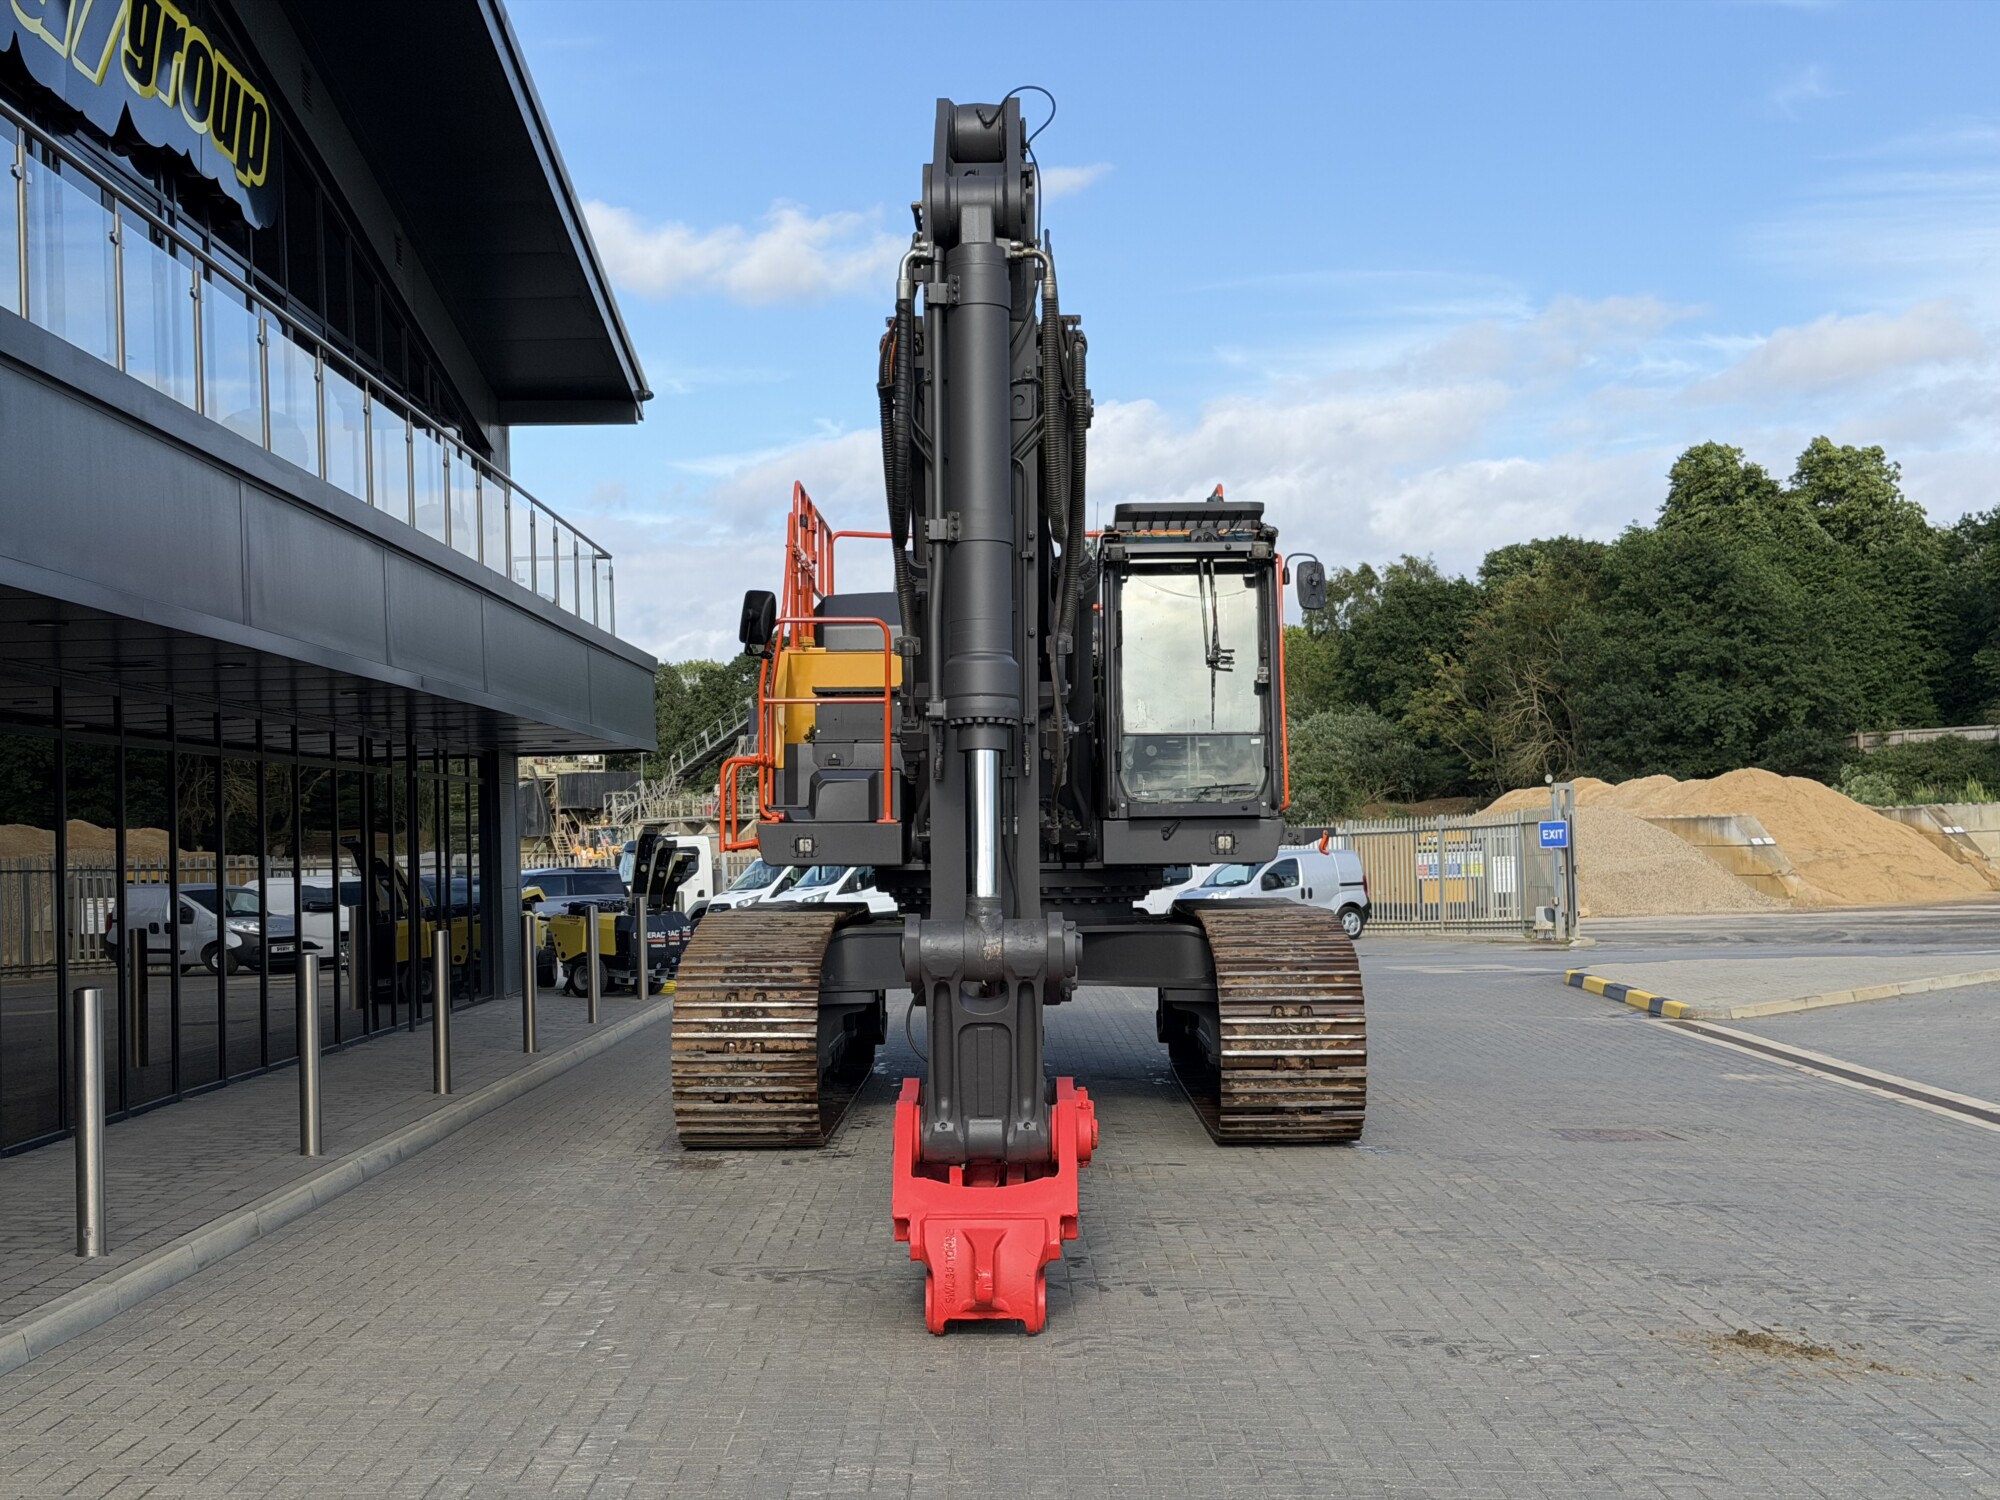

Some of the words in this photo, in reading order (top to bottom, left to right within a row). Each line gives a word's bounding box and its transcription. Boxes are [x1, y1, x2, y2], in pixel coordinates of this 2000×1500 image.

[121, 0, 270, 188] group
[1542, 829, 1564, 840] EXIT
[633, 931, 666, 939] GERAC
